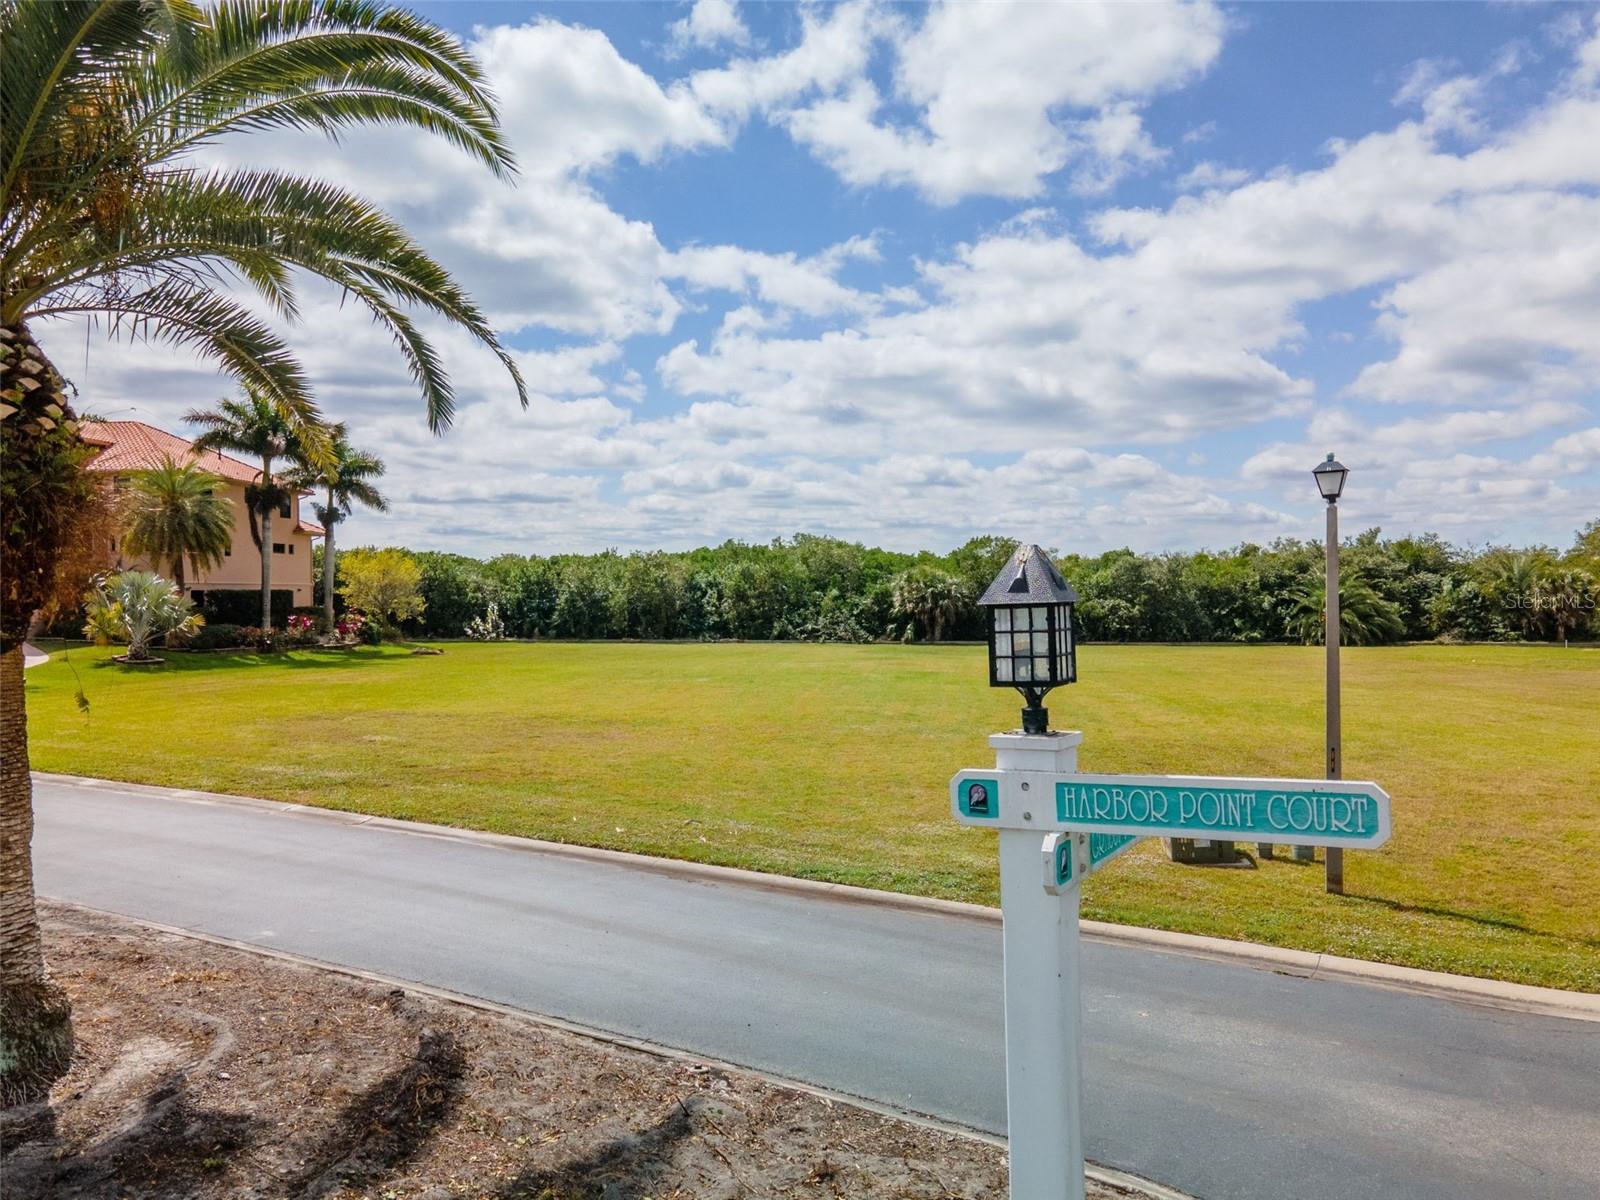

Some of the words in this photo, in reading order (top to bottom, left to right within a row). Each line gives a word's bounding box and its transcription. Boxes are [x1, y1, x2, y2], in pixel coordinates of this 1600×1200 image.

[1063, 786, 1169, 824] HARBOR
[1179, 791, 1256, 828] POINT
[1267, 795, 1368, 834] COURT
